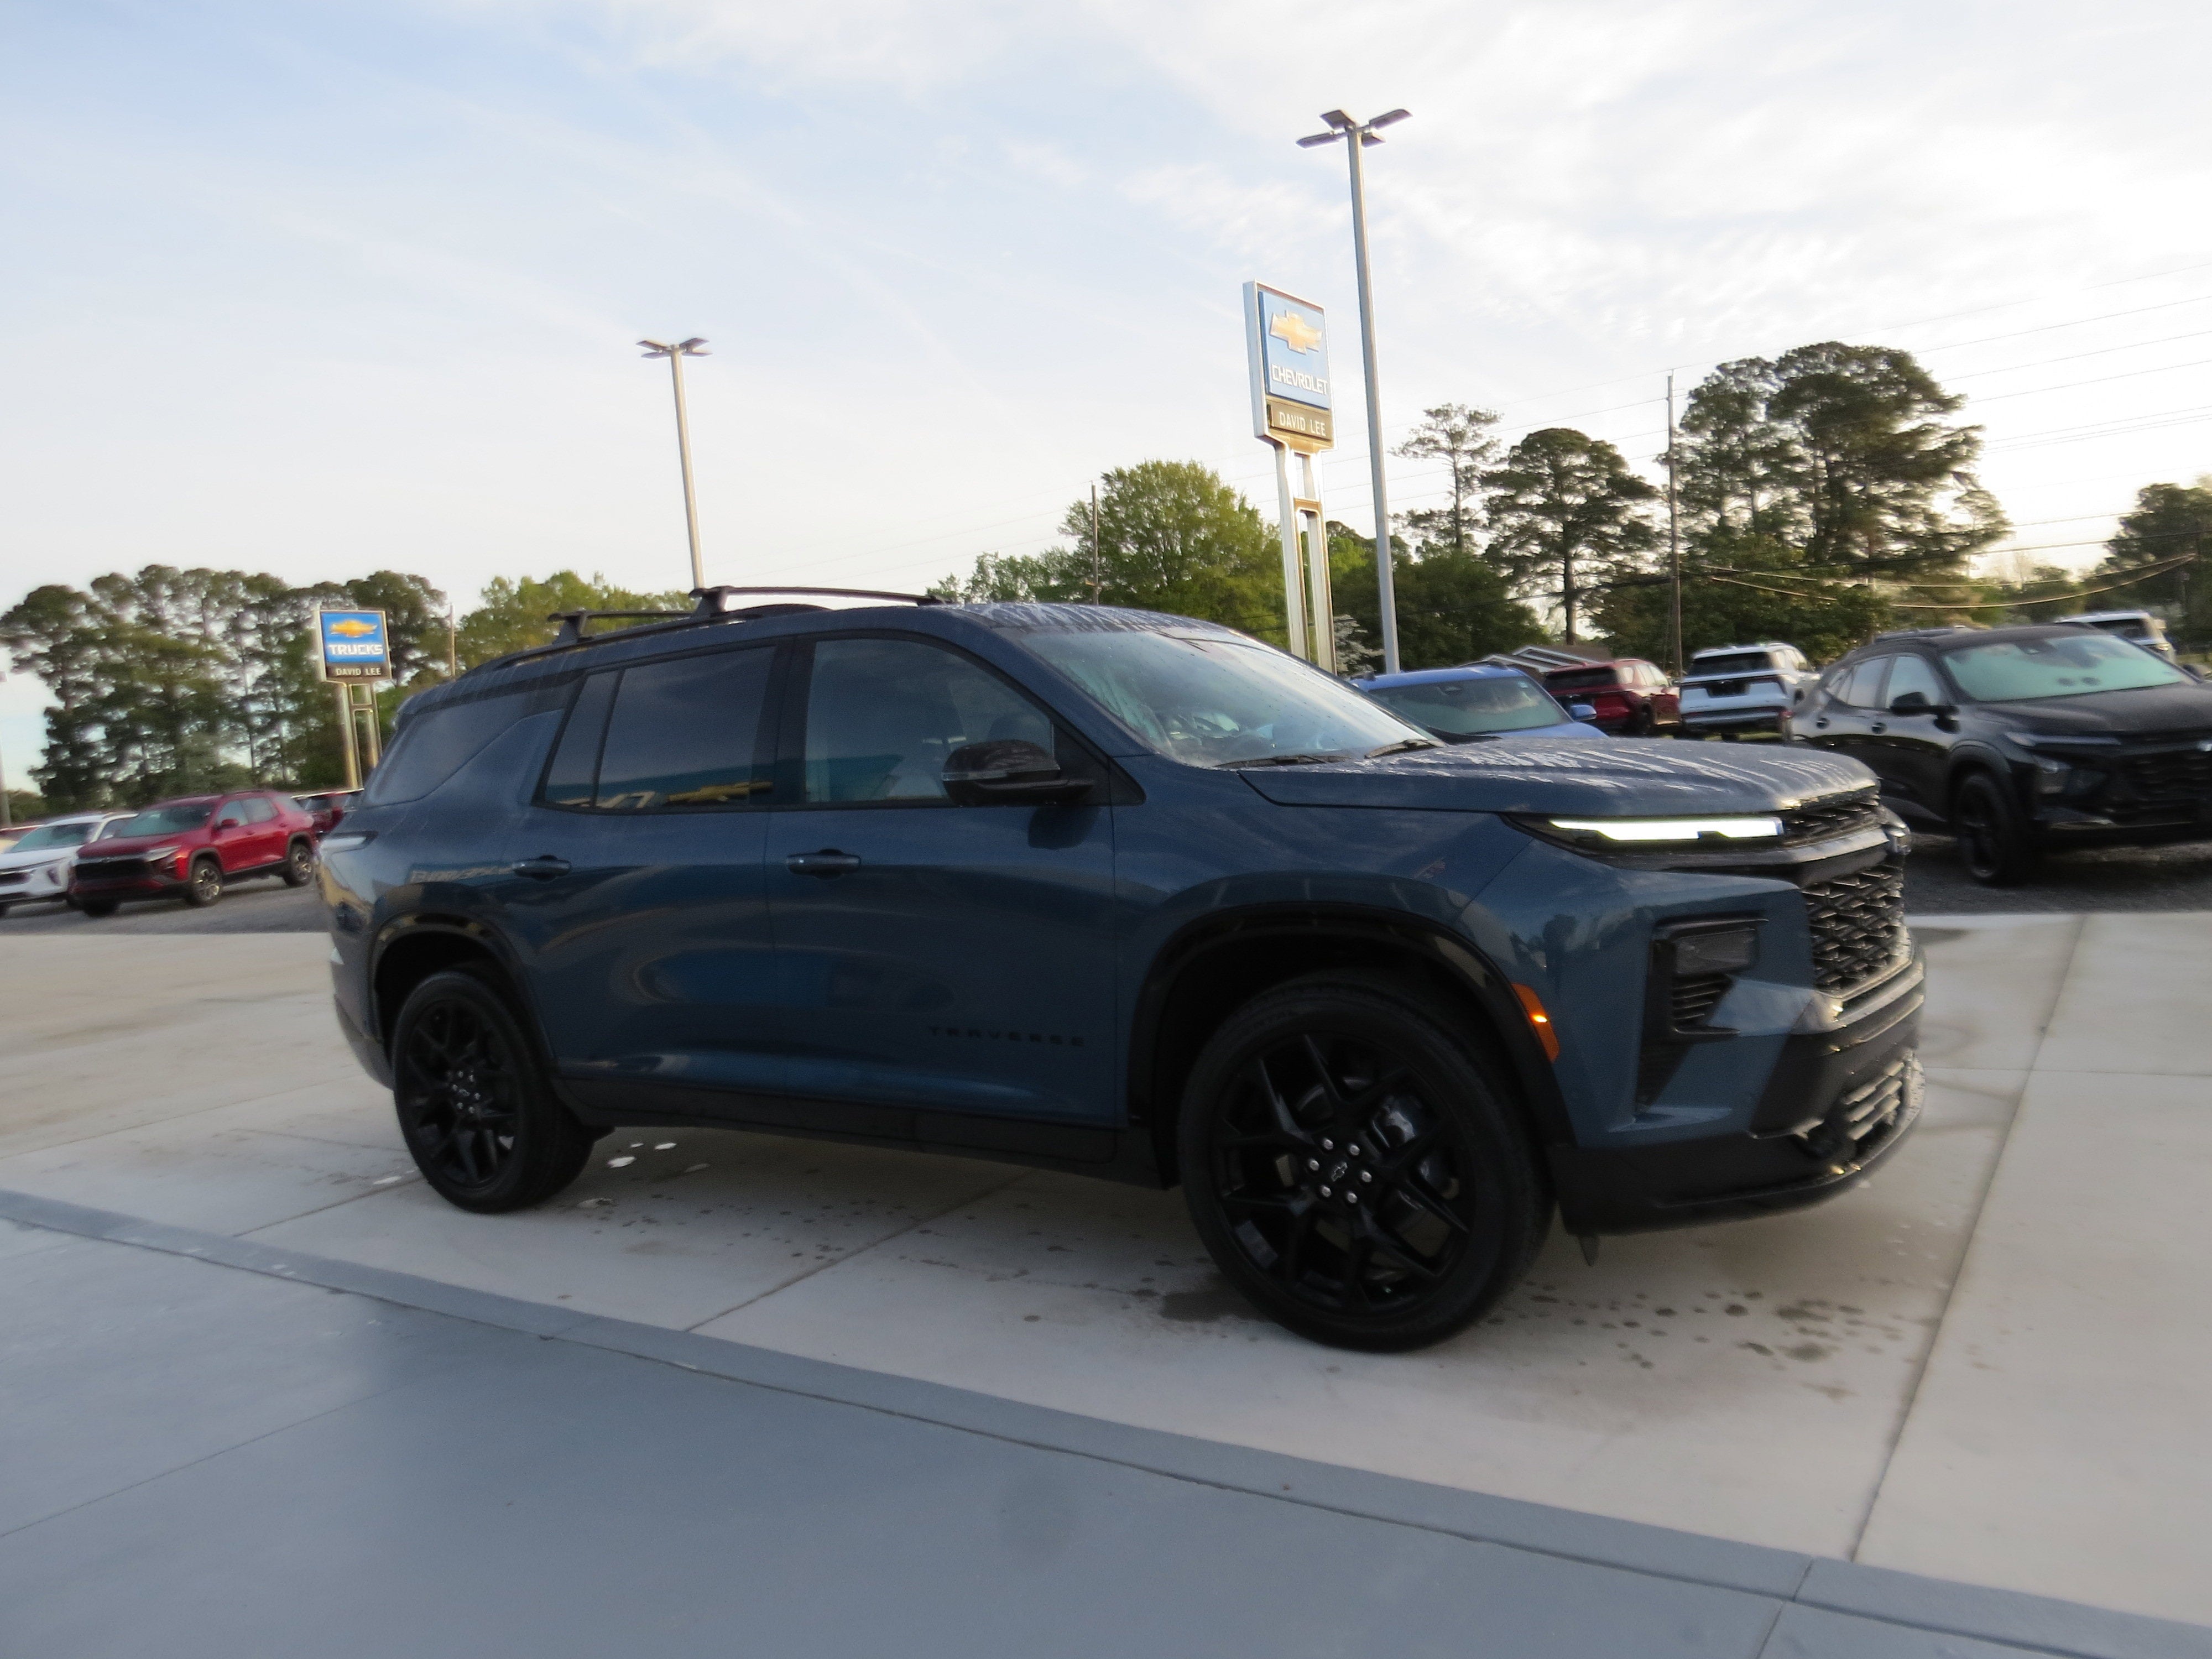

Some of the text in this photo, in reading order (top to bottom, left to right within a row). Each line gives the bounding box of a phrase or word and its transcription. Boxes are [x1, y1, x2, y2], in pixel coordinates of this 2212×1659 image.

[1271, 364, 1328, 395] CHEVROLET
[1279, 411, 1326, 437] DAVID LEE
[327, 644, 383, 655] TRUCKS
[336, 667, 382, 676] DAVID LEE
[928, 1026, 1084, 1047] TRAVERSE
